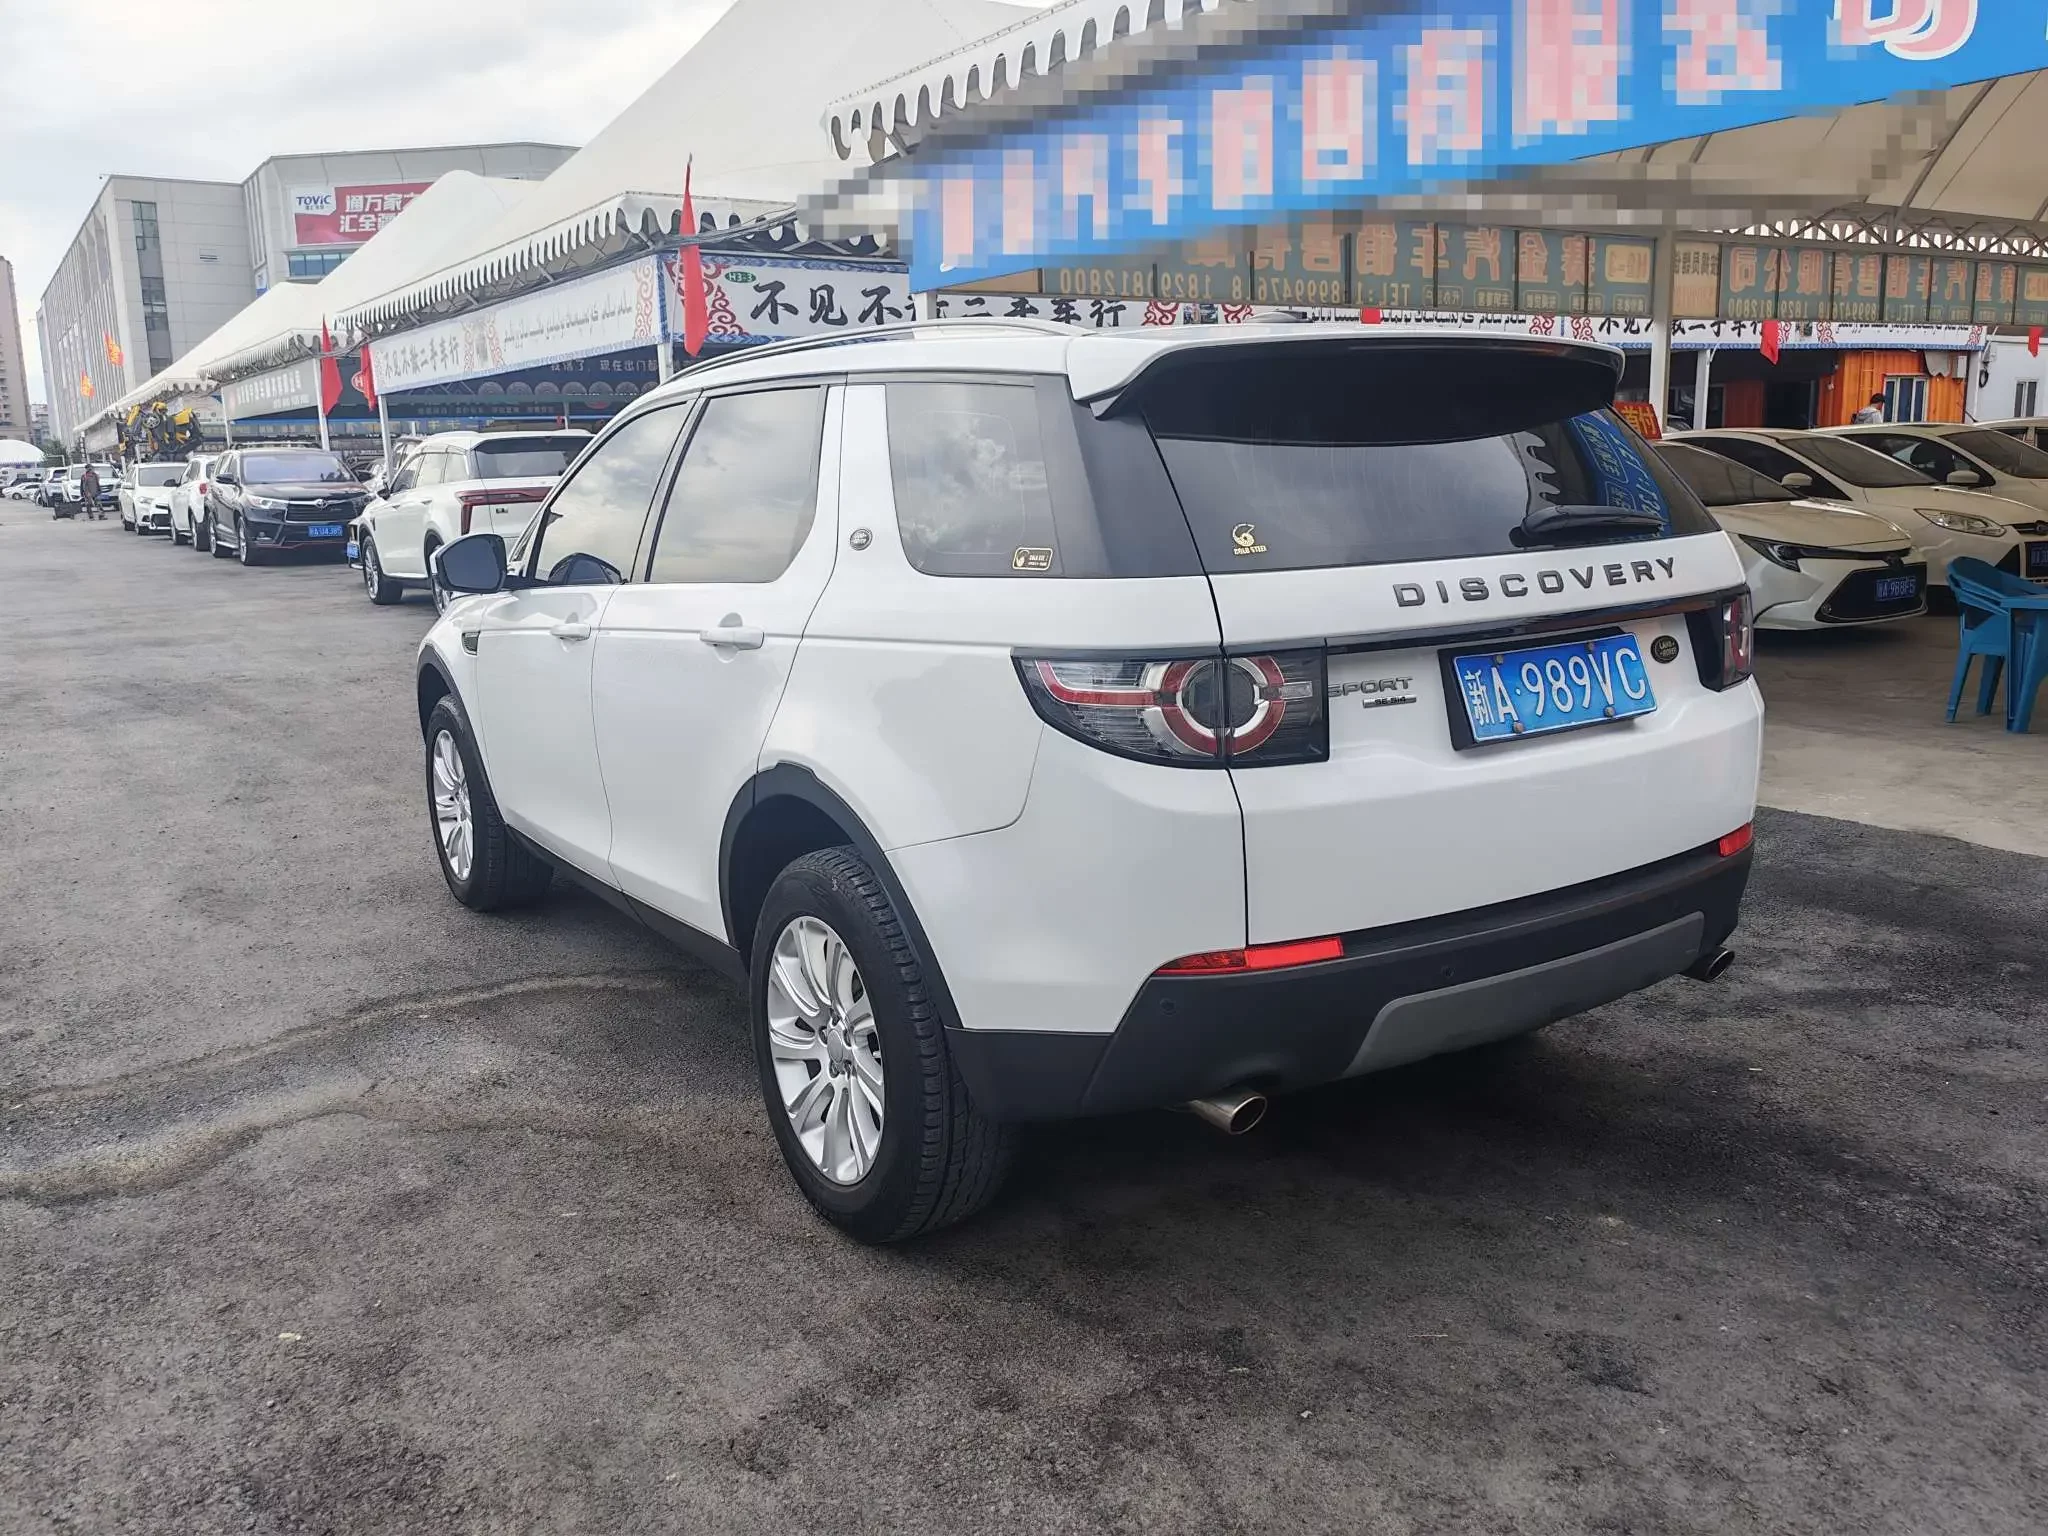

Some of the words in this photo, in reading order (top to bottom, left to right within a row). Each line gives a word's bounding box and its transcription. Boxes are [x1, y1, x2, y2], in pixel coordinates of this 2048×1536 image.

[750, 280, 1128, 327] 不见不二手车行
[1393, 557, 1676, 608] DISCOVERY
[1328, 677, 1414, 698] SPORT
